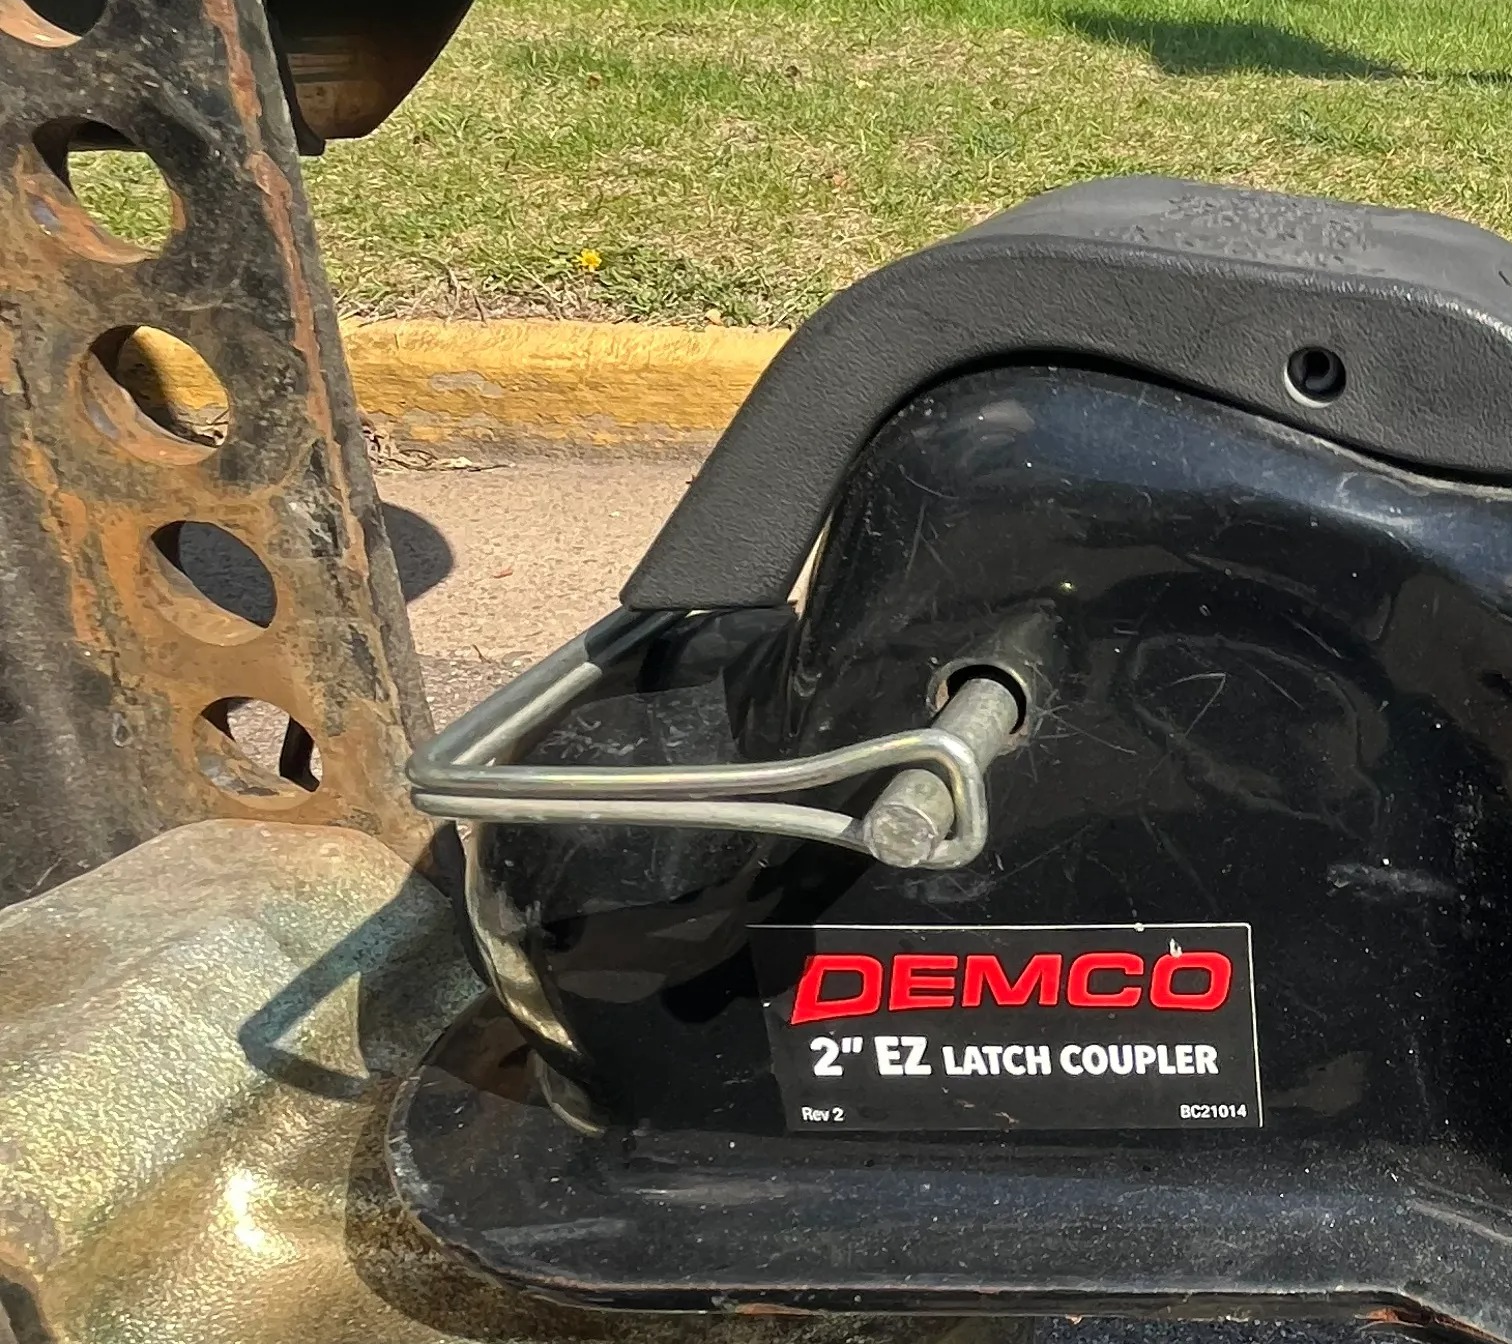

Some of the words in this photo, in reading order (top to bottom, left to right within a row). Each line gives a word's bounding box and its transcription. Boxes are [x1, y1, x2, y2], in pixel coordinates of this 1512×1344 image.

[790, 953, 1233, 1025] DEMCO
[809, 1036, 863, 1077] 2"
[874, 1036, 932, 1076] EZ
[942, 1045, 1052, 1076] LATCH
[1060, 1045, 1219, 1075] COUPLER
[802, 1106, 831, 1122] Rev
[834, 1107, 844, 1121] 2
[1180, 1104, 1247, 1118] BC21014
